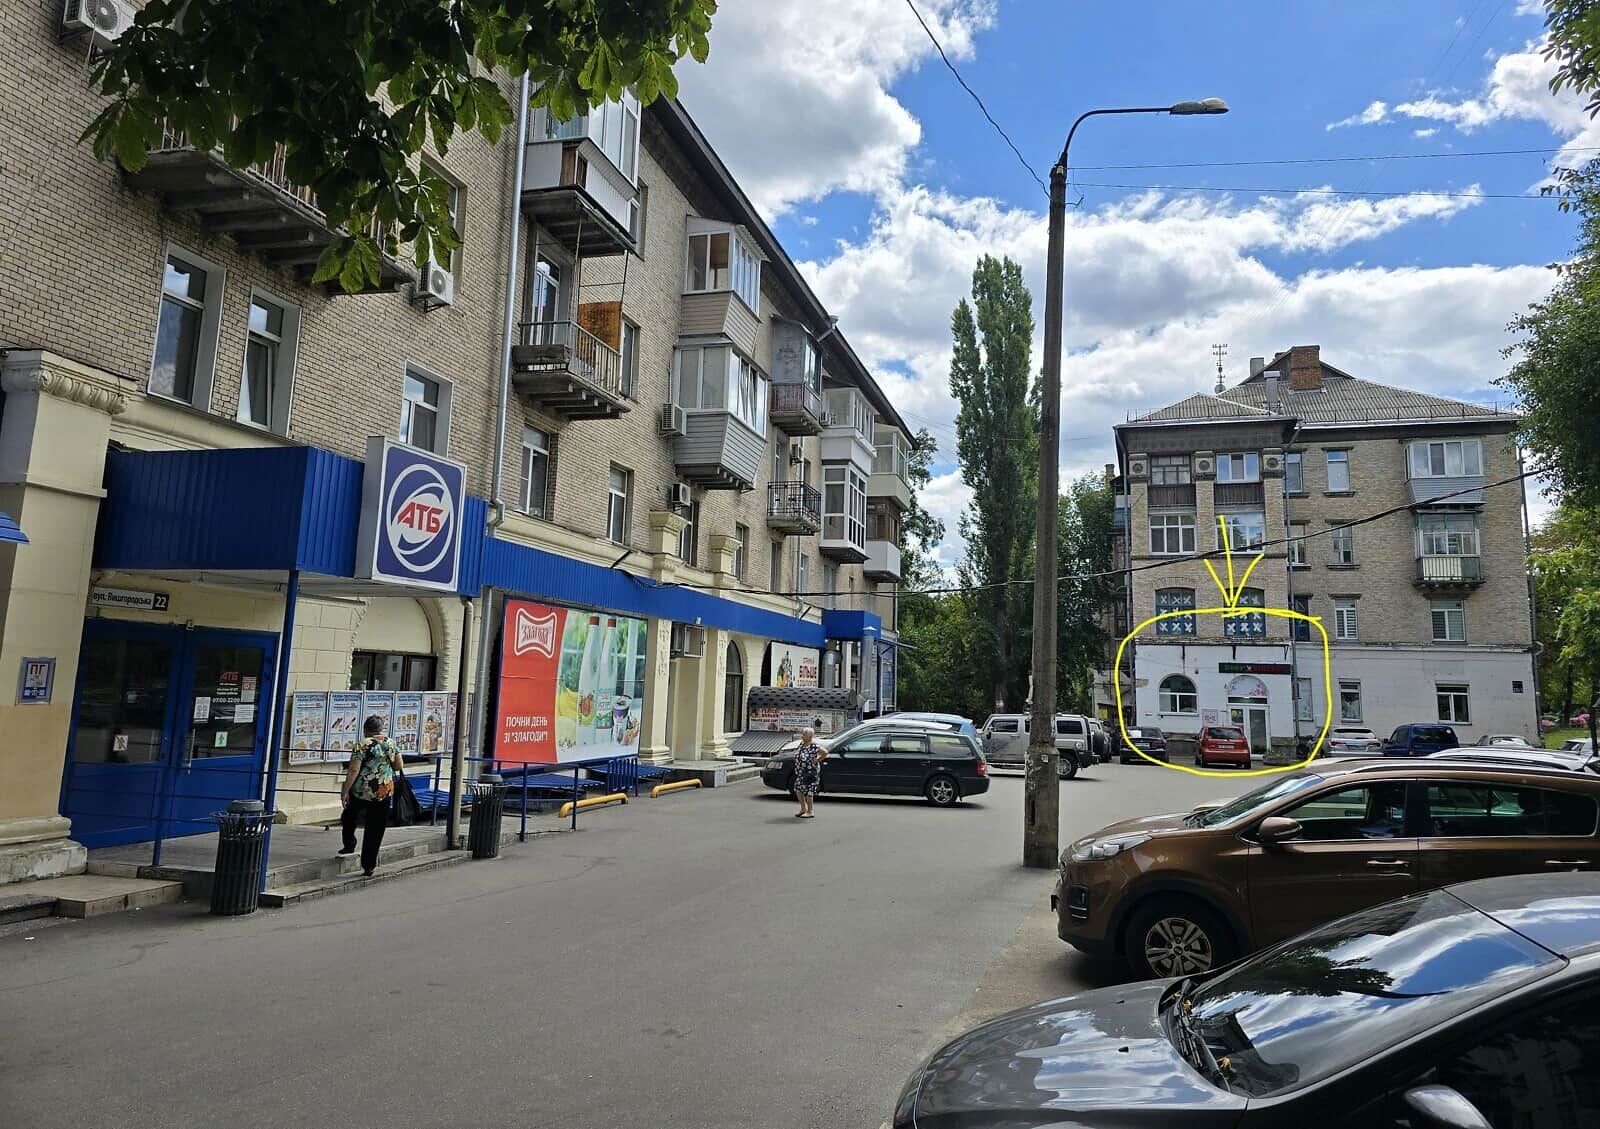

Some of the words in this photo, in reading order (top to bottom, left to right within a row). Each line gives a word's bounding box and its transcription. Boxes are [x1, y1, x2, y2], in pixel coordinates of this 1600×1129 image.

[397, 501, 444, 534] АТБ
[154, 596, 168, 608] 22
[30, 664, 46, 675] ПГ
[219, 671, 239, 681] АТБ
[505, 716, 530, 728] ПОЧНИ
[531, 716, 548, 728] ДЕНЬ
